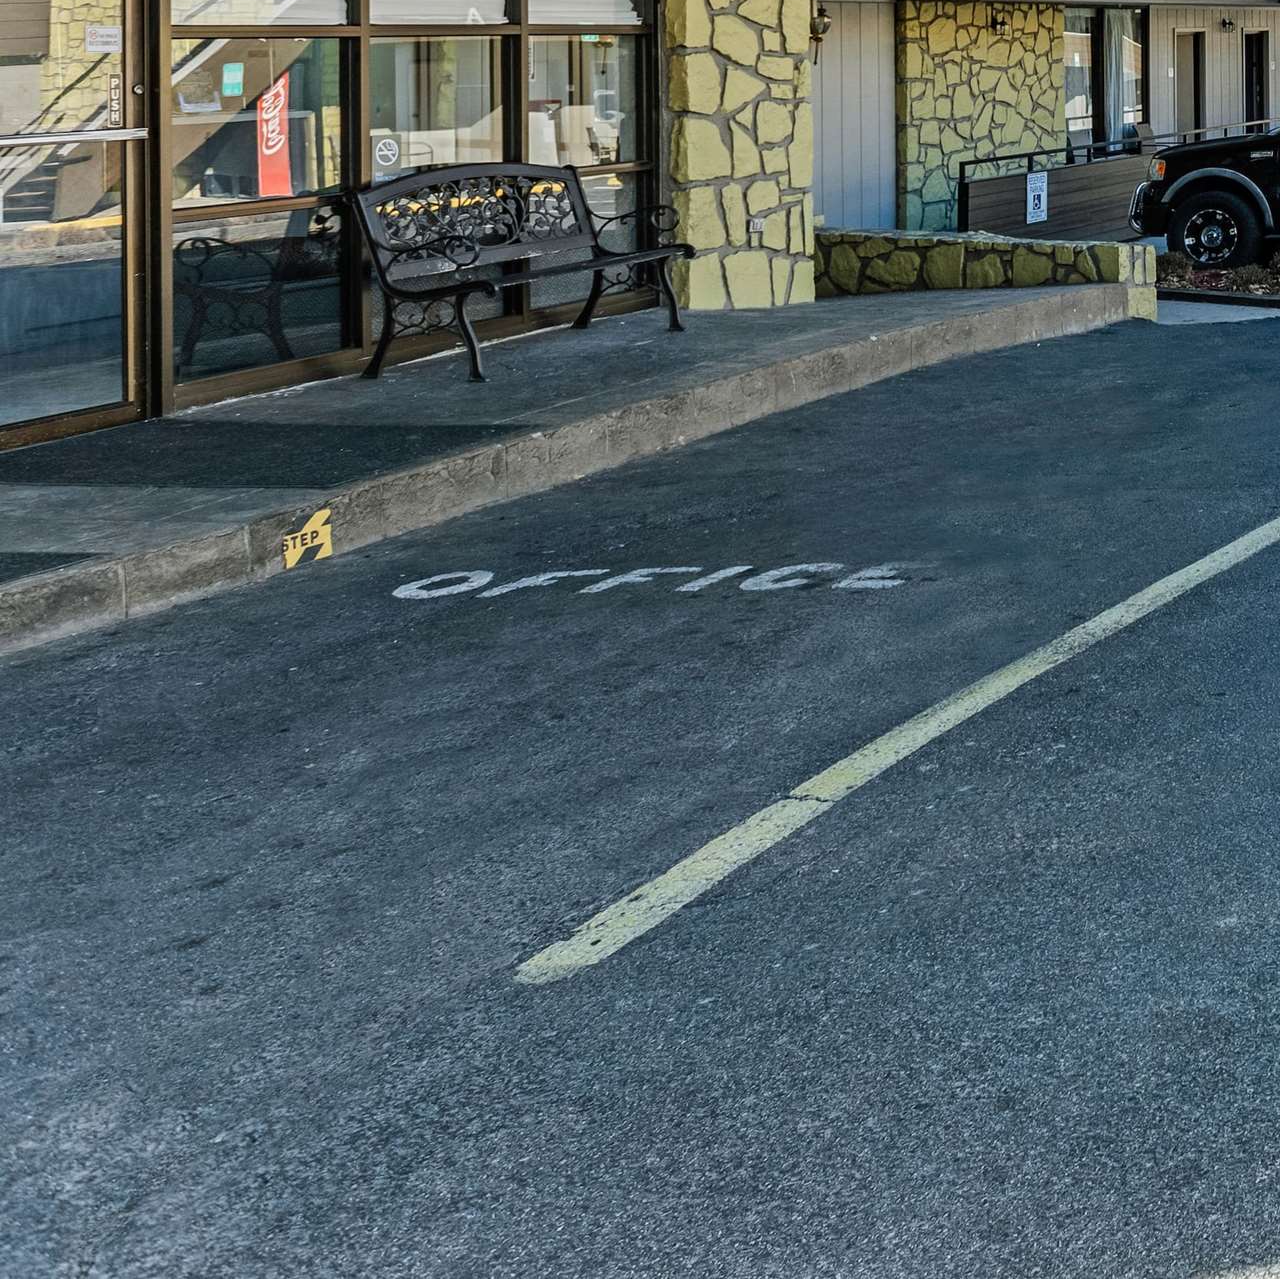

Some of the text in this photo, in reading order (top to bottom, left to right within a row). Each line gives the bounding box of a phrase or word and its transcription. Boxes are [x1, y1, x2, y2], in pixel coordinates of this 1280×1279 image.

[110, 78, 120, 122] PUSH
[281, 530, 319, 554] STEP
[392, 562, 932, 599] OFFICE
